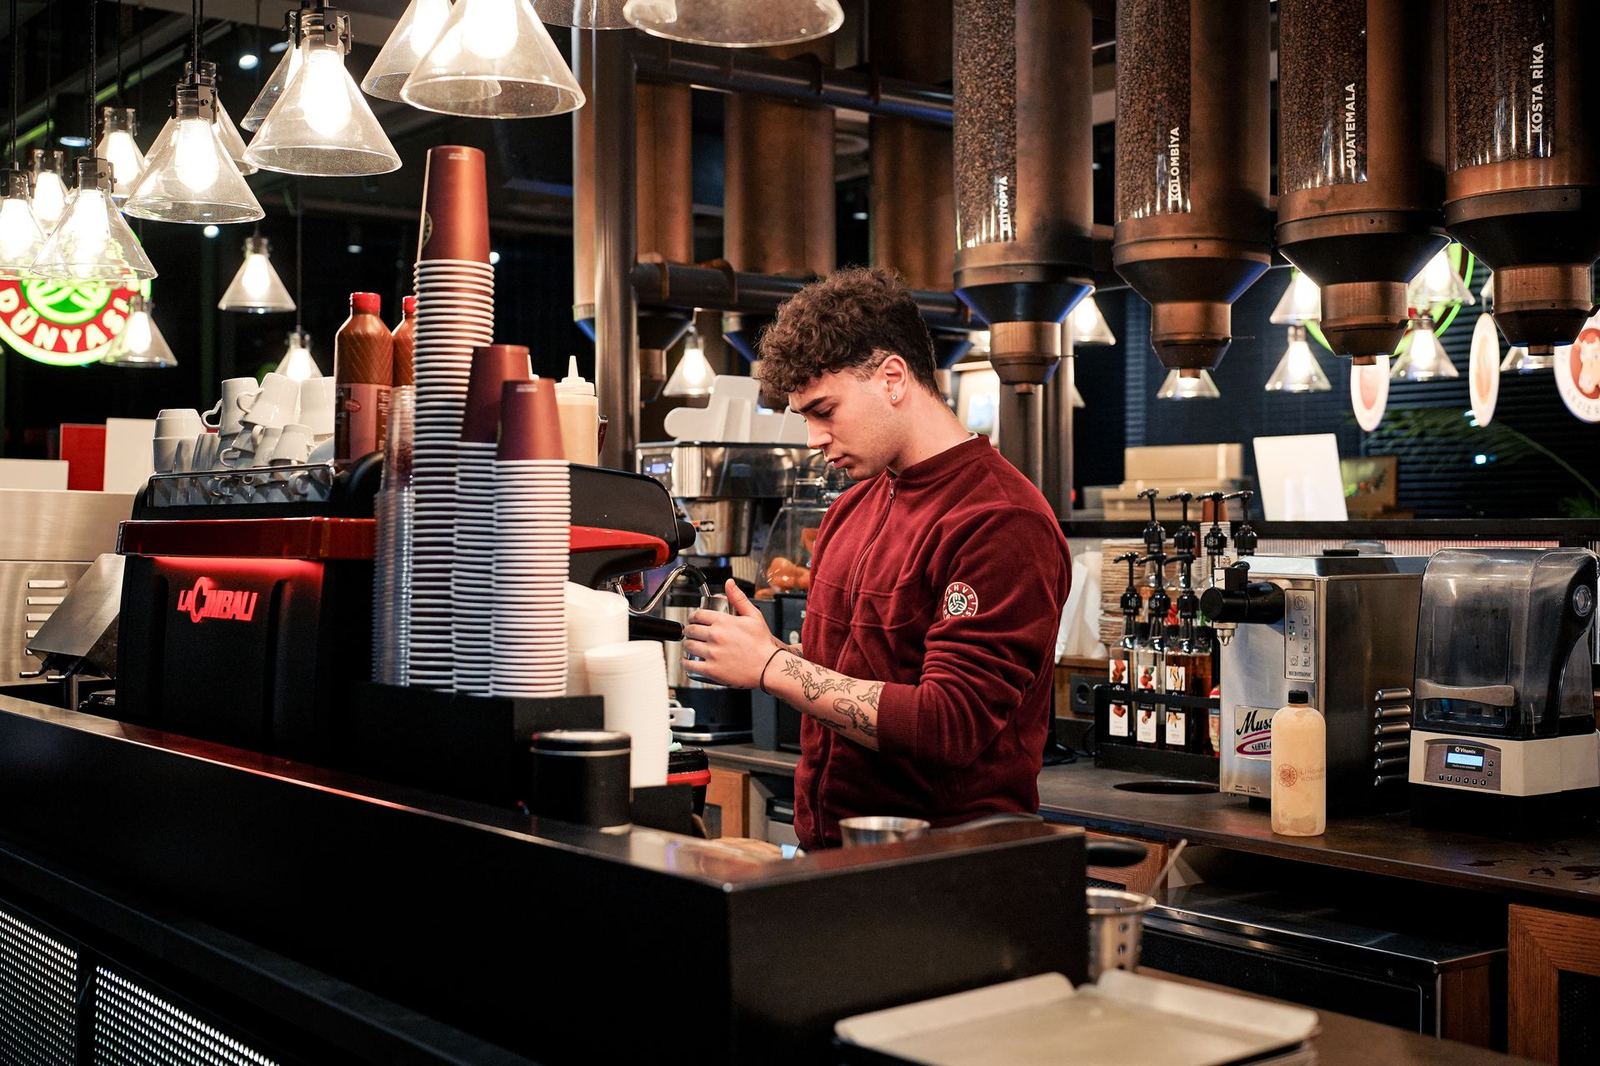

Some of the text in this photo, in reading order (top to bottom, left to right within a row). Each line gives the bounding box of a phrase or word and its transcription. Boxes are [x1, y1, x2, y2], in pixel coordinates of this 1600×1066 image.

[1345, 83, 1357, 169] GUATEMALA
[1529, 43, 1544, 133] KOSTA RİKA
[1168, 127, 1180, 201] KOLOMBİYA
